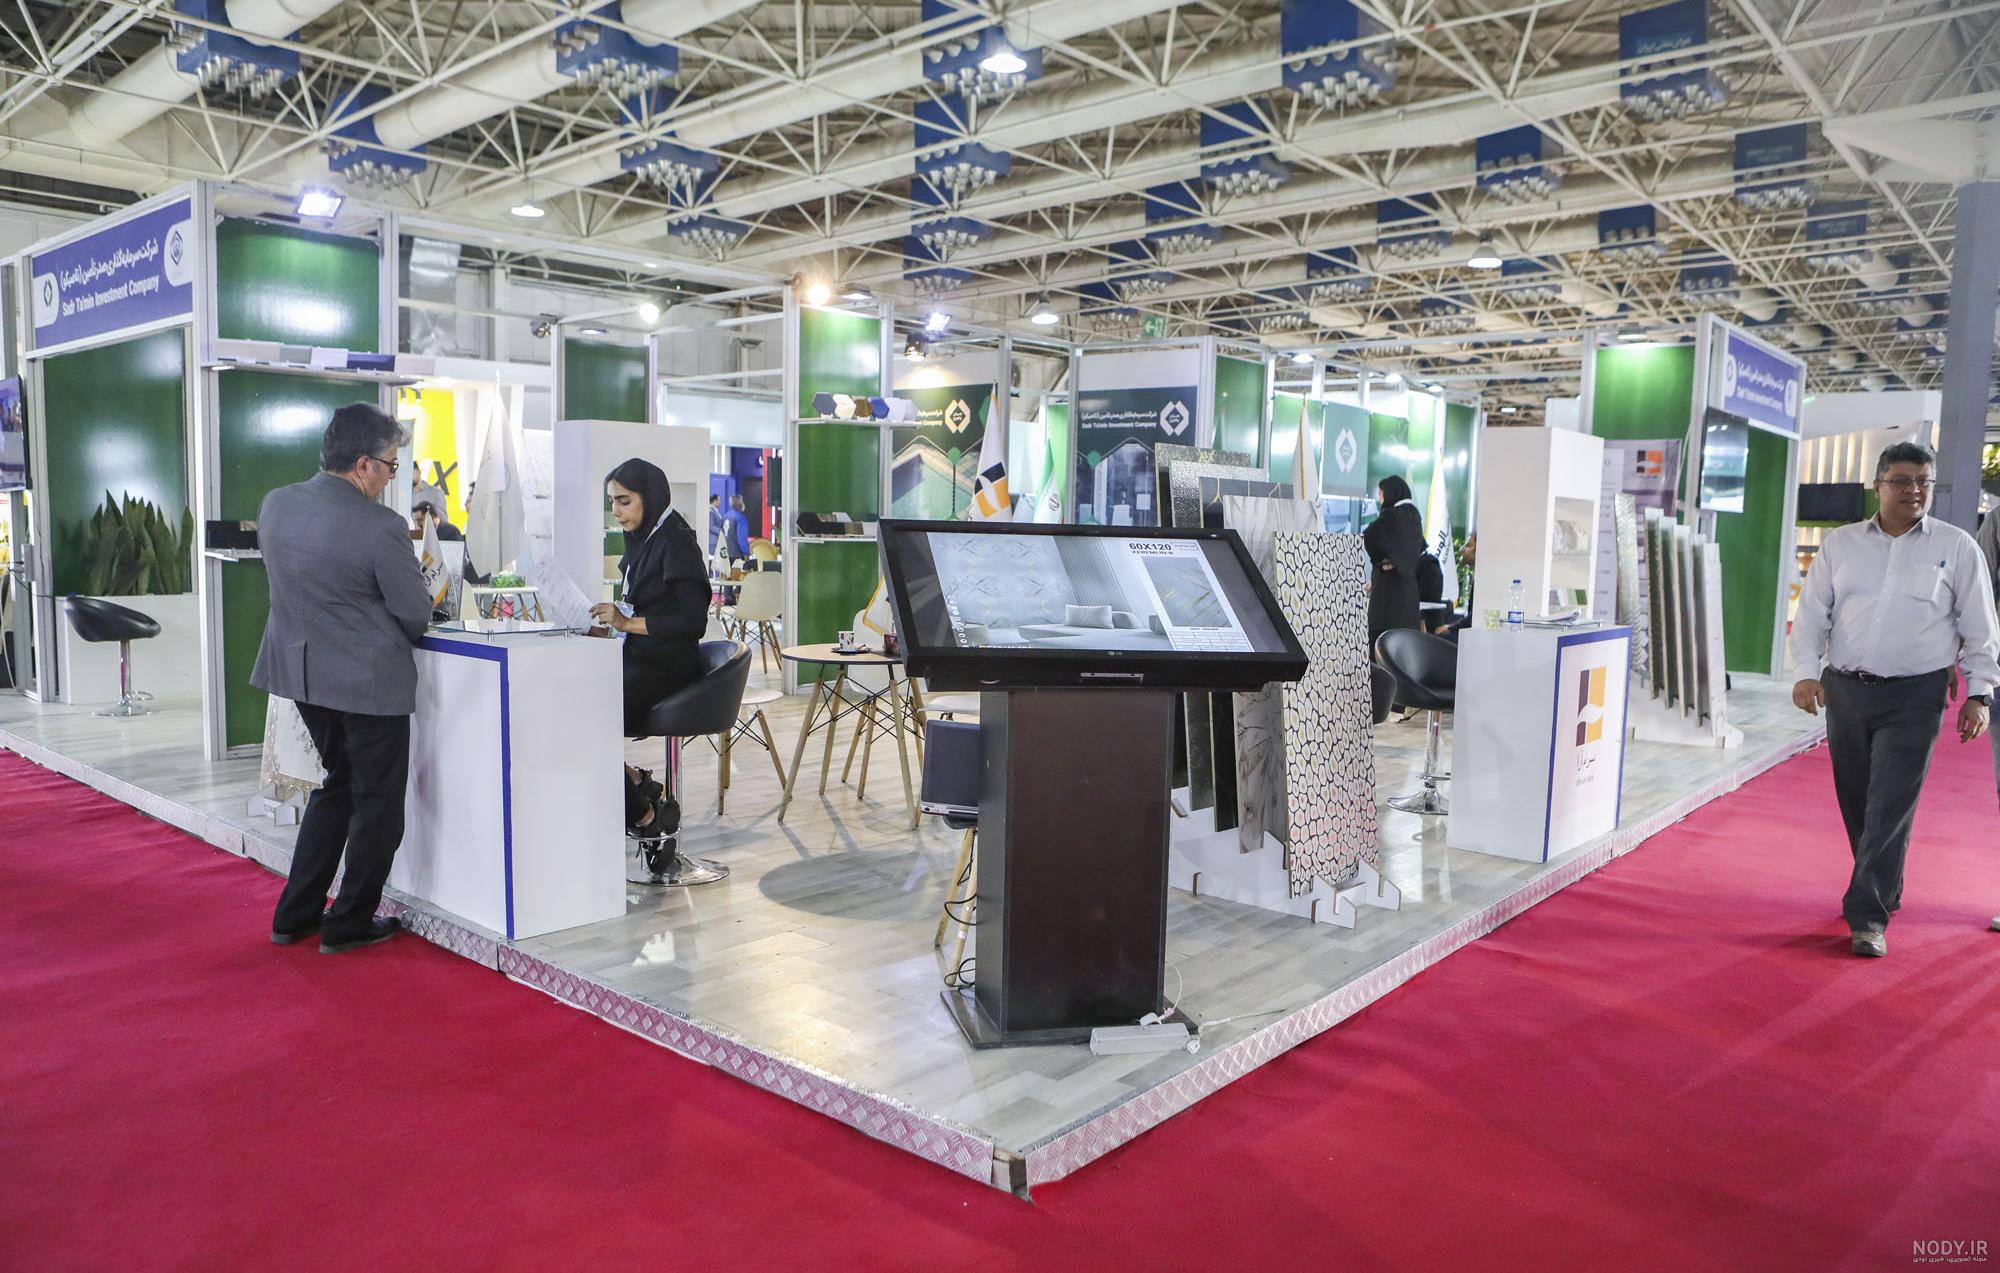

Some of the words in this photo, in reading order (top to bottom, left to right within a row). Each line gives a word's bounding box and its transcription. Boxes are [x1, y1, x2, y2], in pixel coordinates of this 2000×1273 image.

[142, 238, 159, 261] شرکت
[95, 284, 128, 306] Investment
[128, 275, 160, 297] Company
